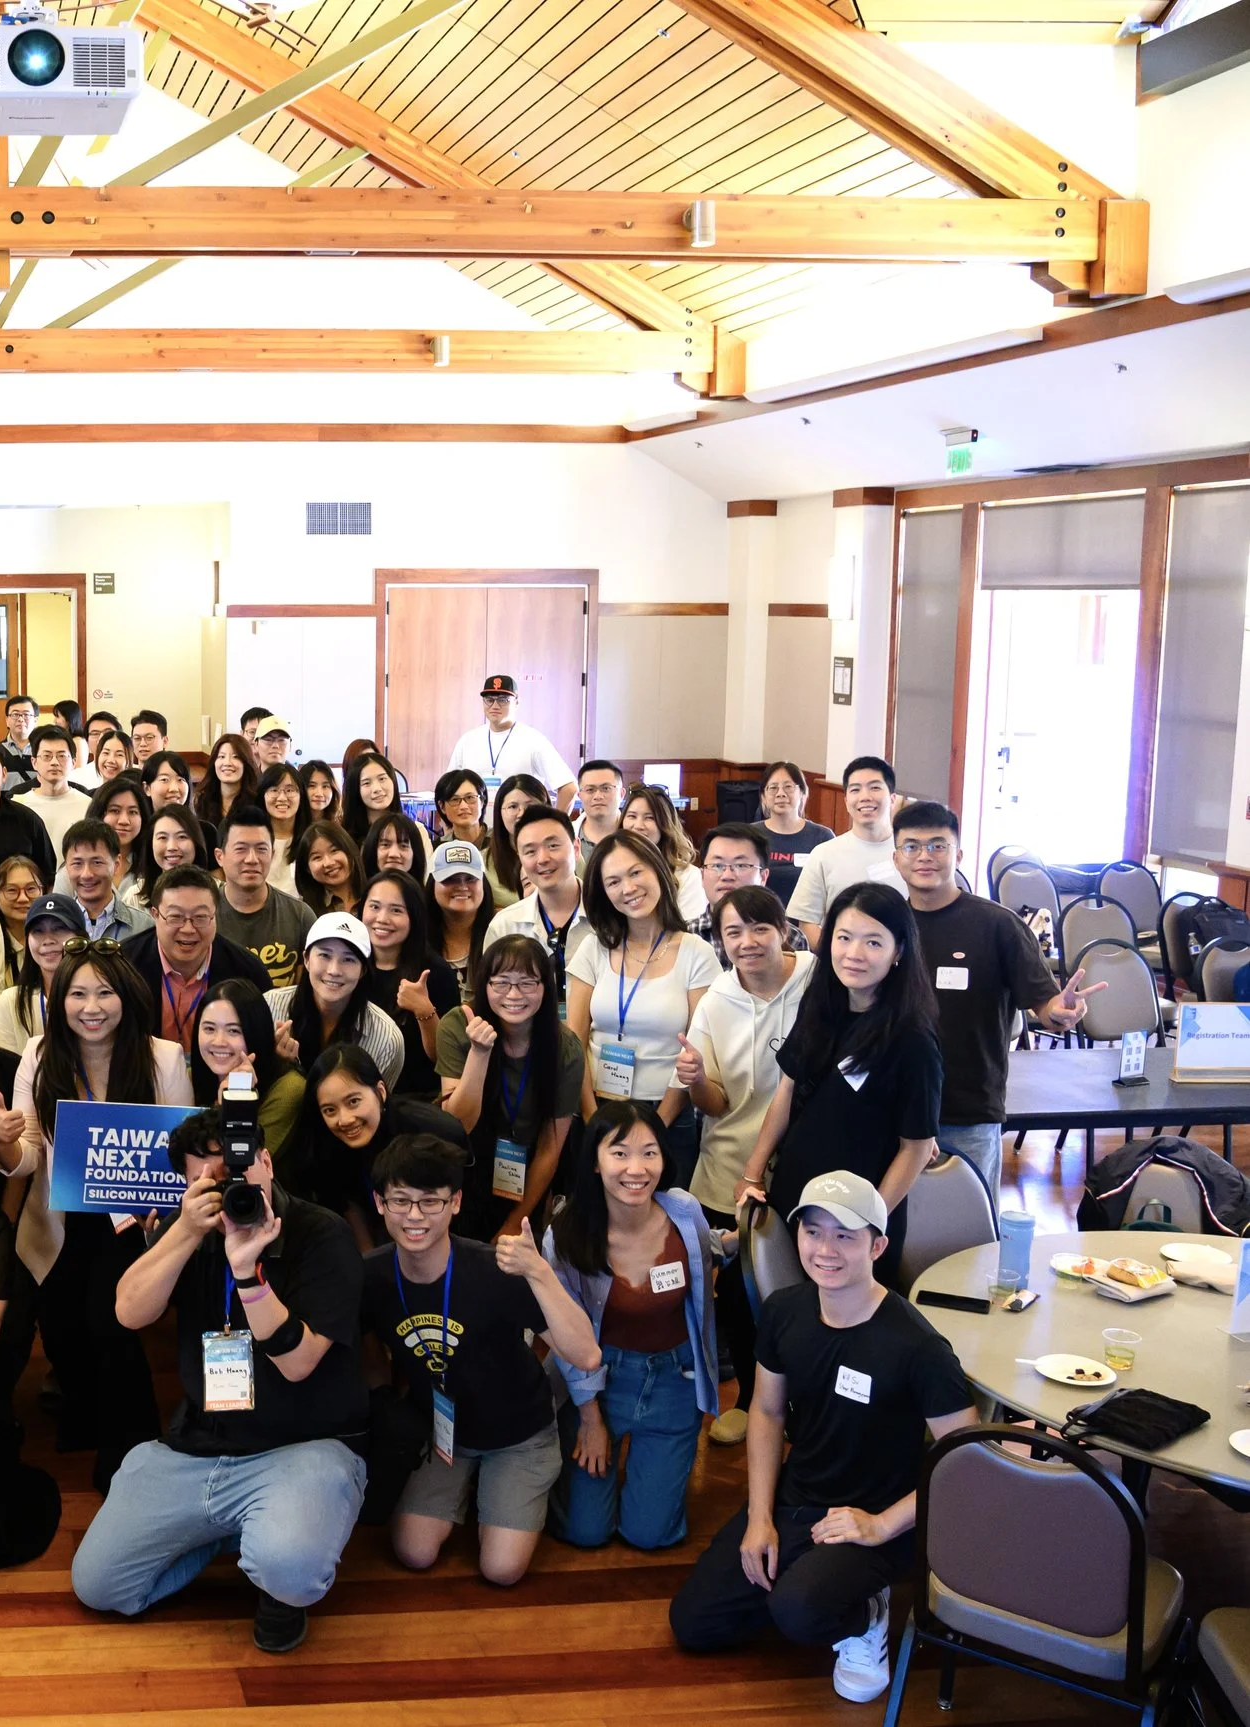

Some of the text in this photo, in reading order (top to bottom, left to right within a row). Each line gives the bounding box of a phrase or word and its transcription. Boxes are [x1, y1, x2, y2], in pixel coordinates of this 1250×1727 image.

[46, 901, 55, 910] C
[603, 1063, 619, 1071] Carol
[86, 1147, 151, 1169] NEXT
[85, 1168, 187, 1184] FOUNDATION
[88, 1188, 183, 1203] SILICON VALLEY
[399, 1316, 461, 1334] HAPPINES IS
[209, 1367, 223, 1375] Bob
[210, 1400, 247, 1409] TEAM LEADER
